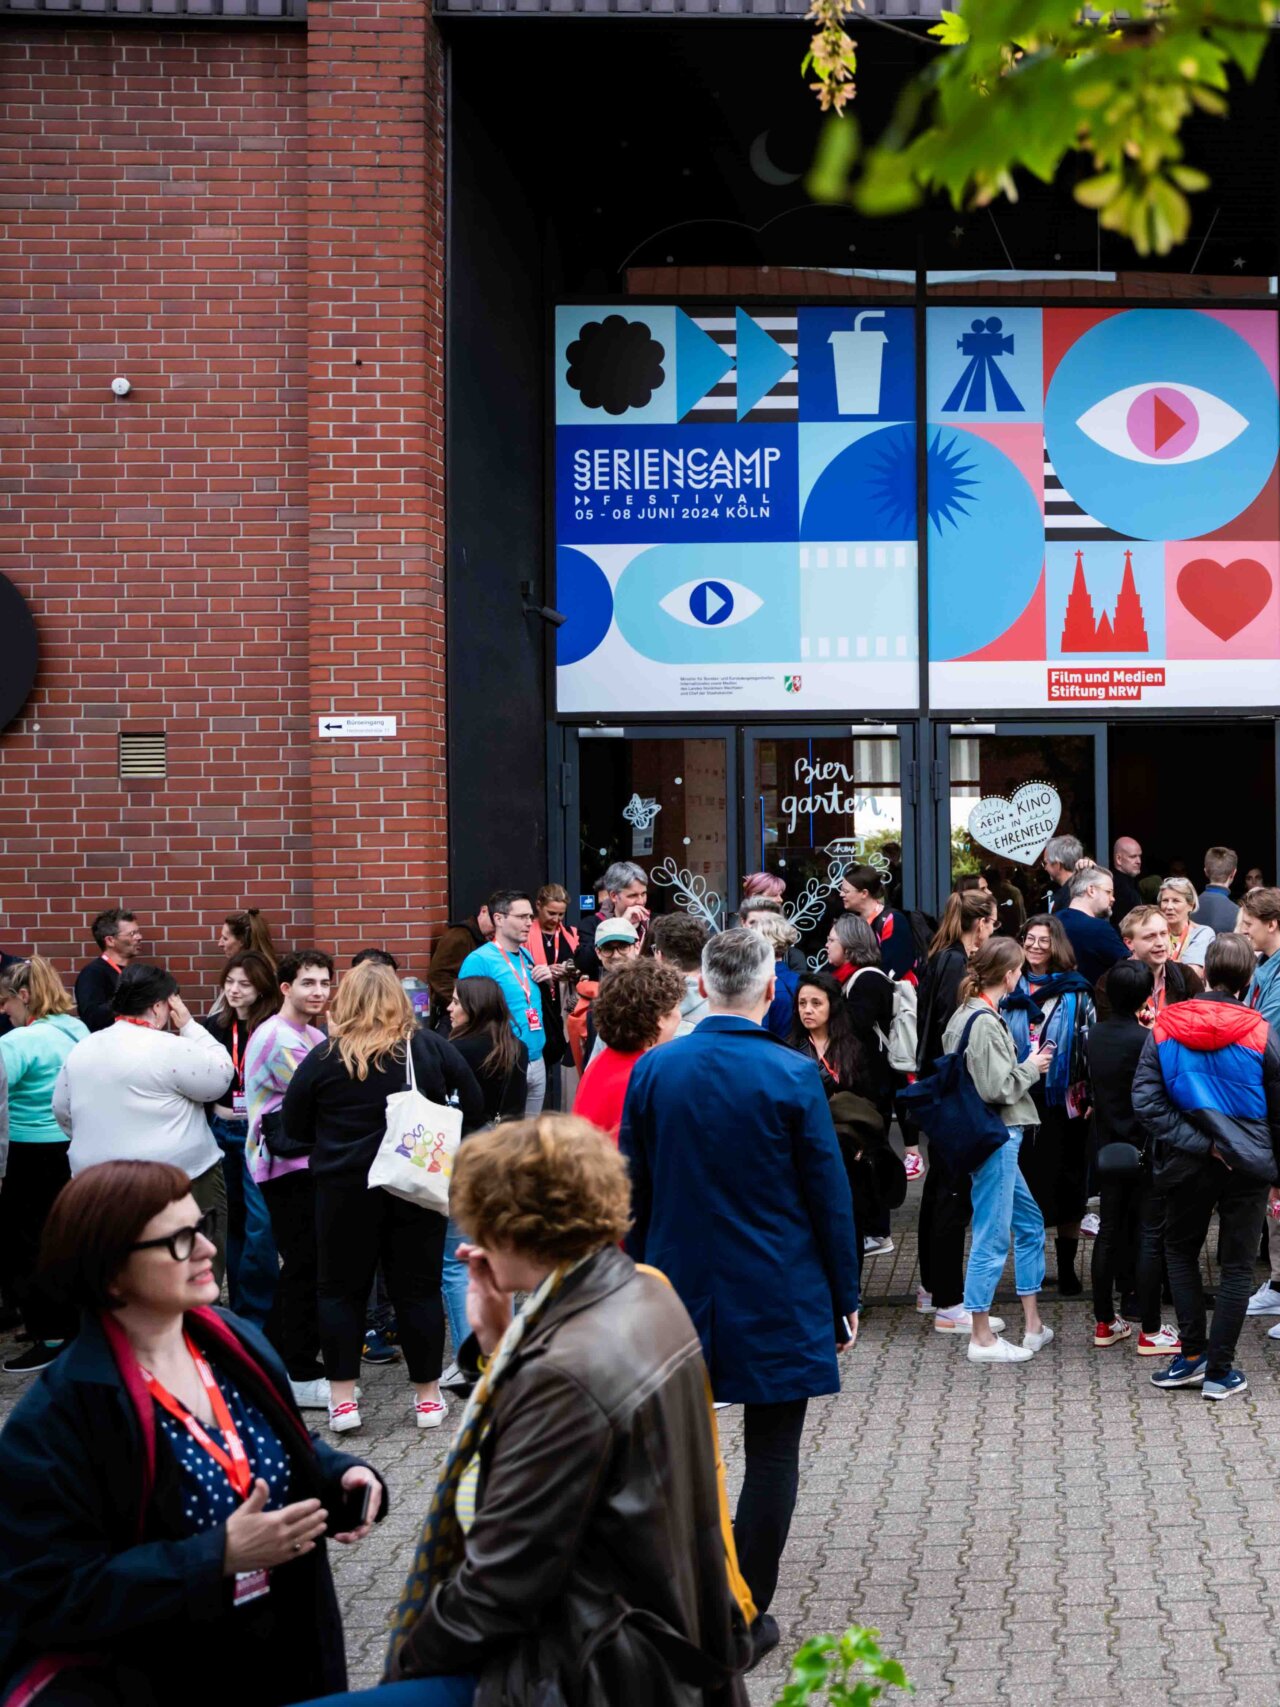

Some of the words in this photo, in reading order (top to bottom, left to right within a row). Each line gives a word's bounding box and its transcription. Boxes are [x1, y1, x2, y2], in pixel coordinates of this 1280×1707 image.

[573, 447, 781, 491] SERIENCAMP
[603, 493, 770, 506] FESTIVAL
[574, 509, 594, 520] 05
[612, 508, 631, 520] 08
[637, 508, 675, 520] JUNI
[682, 507, 720, 519] 2024
[726, 505, 770, 519] KÖLN
[1051, 671, 1082, 684] Film
[1084, 671, 1110, 683] und
[1113, 670, 1163, 683] Medien
[1051, 685, 1106, 699] Stiftung
[1108, 686, 1139, 697] NRW
[794, 757, 854, 785] Bier
[1016, 792, 1051, 816] KINO
[1011, 818, 1021, 828] IN
[994, 819, 1054, 849] EHRENFELD
